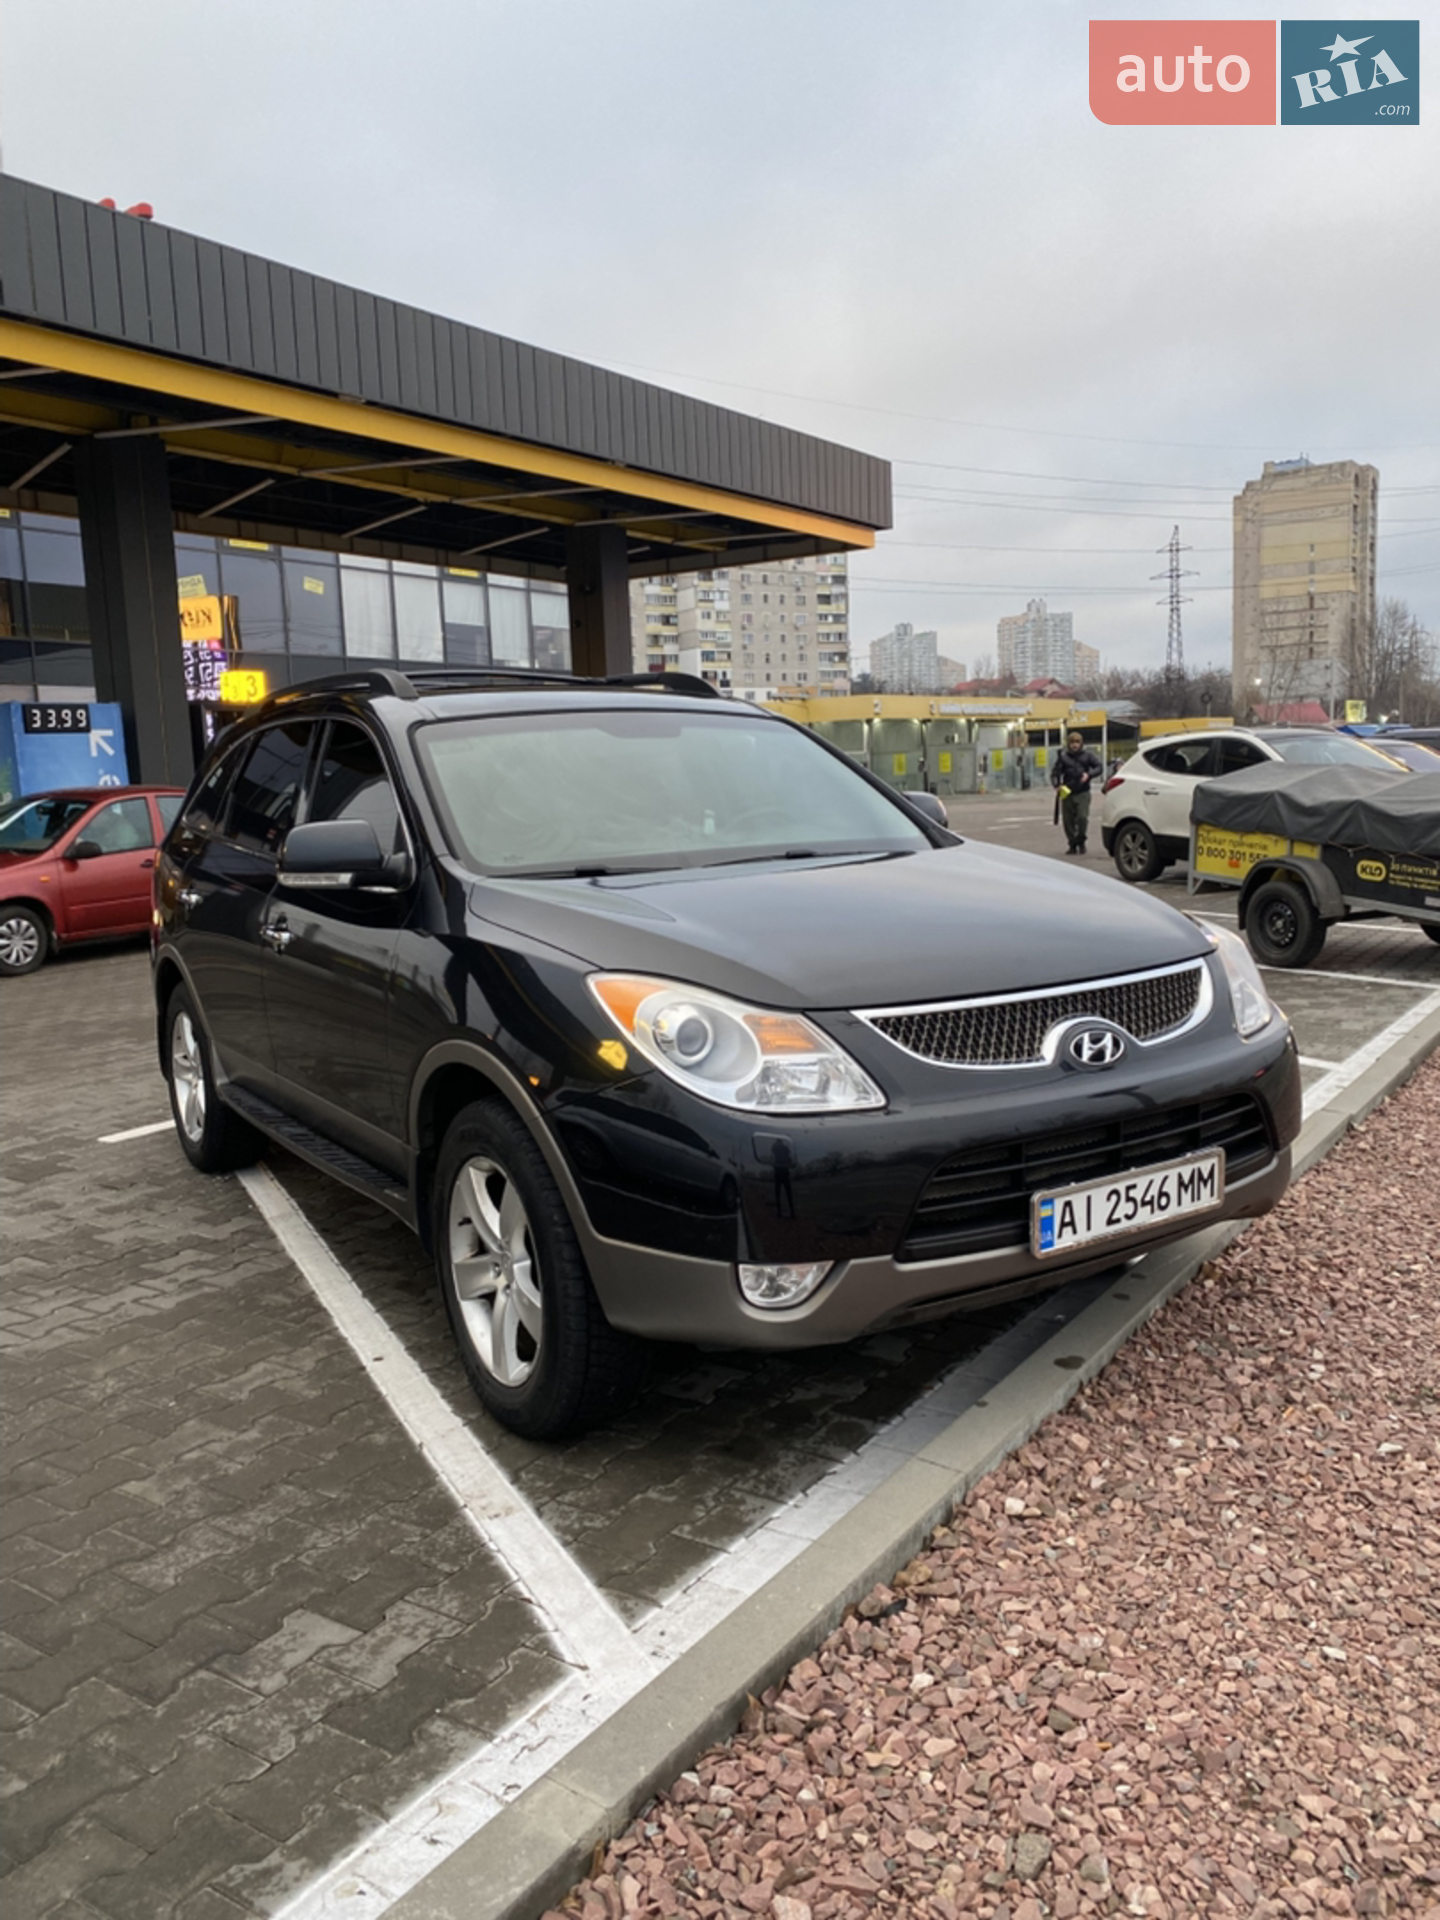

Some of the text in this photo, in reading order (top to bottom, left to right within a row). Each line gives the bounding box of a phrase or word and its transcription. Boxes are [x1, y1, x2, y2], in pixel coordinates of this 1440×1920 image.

[31, 708, 87, 729] 33.99
[1198, 845, 1205, 857] 0
[1206, 846, 1228, 860] 800
[1229, 848, 1247, 863] 301
[1360, 864, 1383, 877] KLO
[1057, 1162, 1216, 1240] AI 2546 MM
